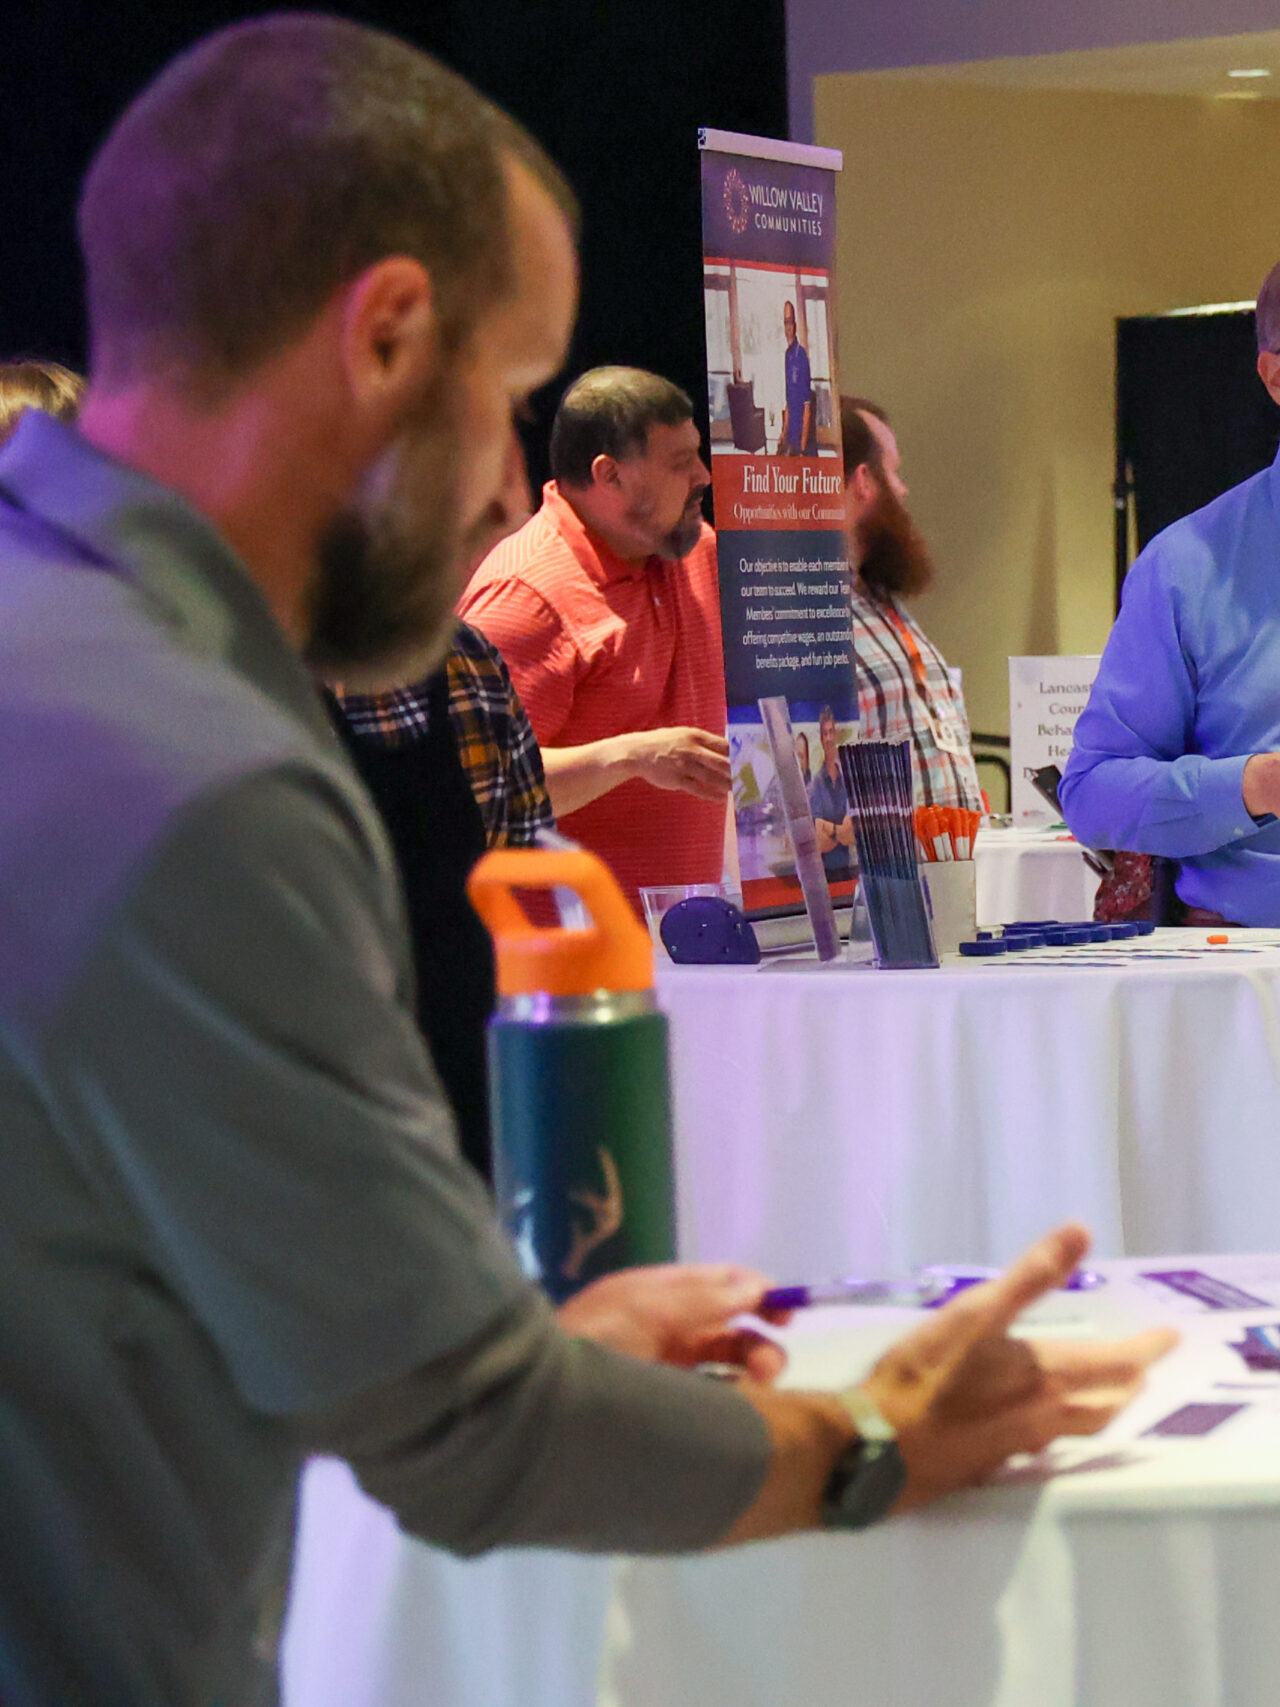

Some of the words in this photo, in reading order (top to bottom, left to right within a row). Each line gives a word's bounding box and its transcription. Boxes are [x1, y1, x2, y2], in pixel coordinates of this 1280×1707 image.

[749, 184, 788, 209] WILLOW
[789, 190, 824, 217] VALLEY
[754, 213, 822, 237] COMMUNITIES
[743, 465, 770, 493] Find
[772, 465, 800, 494] Your
[802, 466, 842, 495] Future
[740, 558, 753, 573] Our
